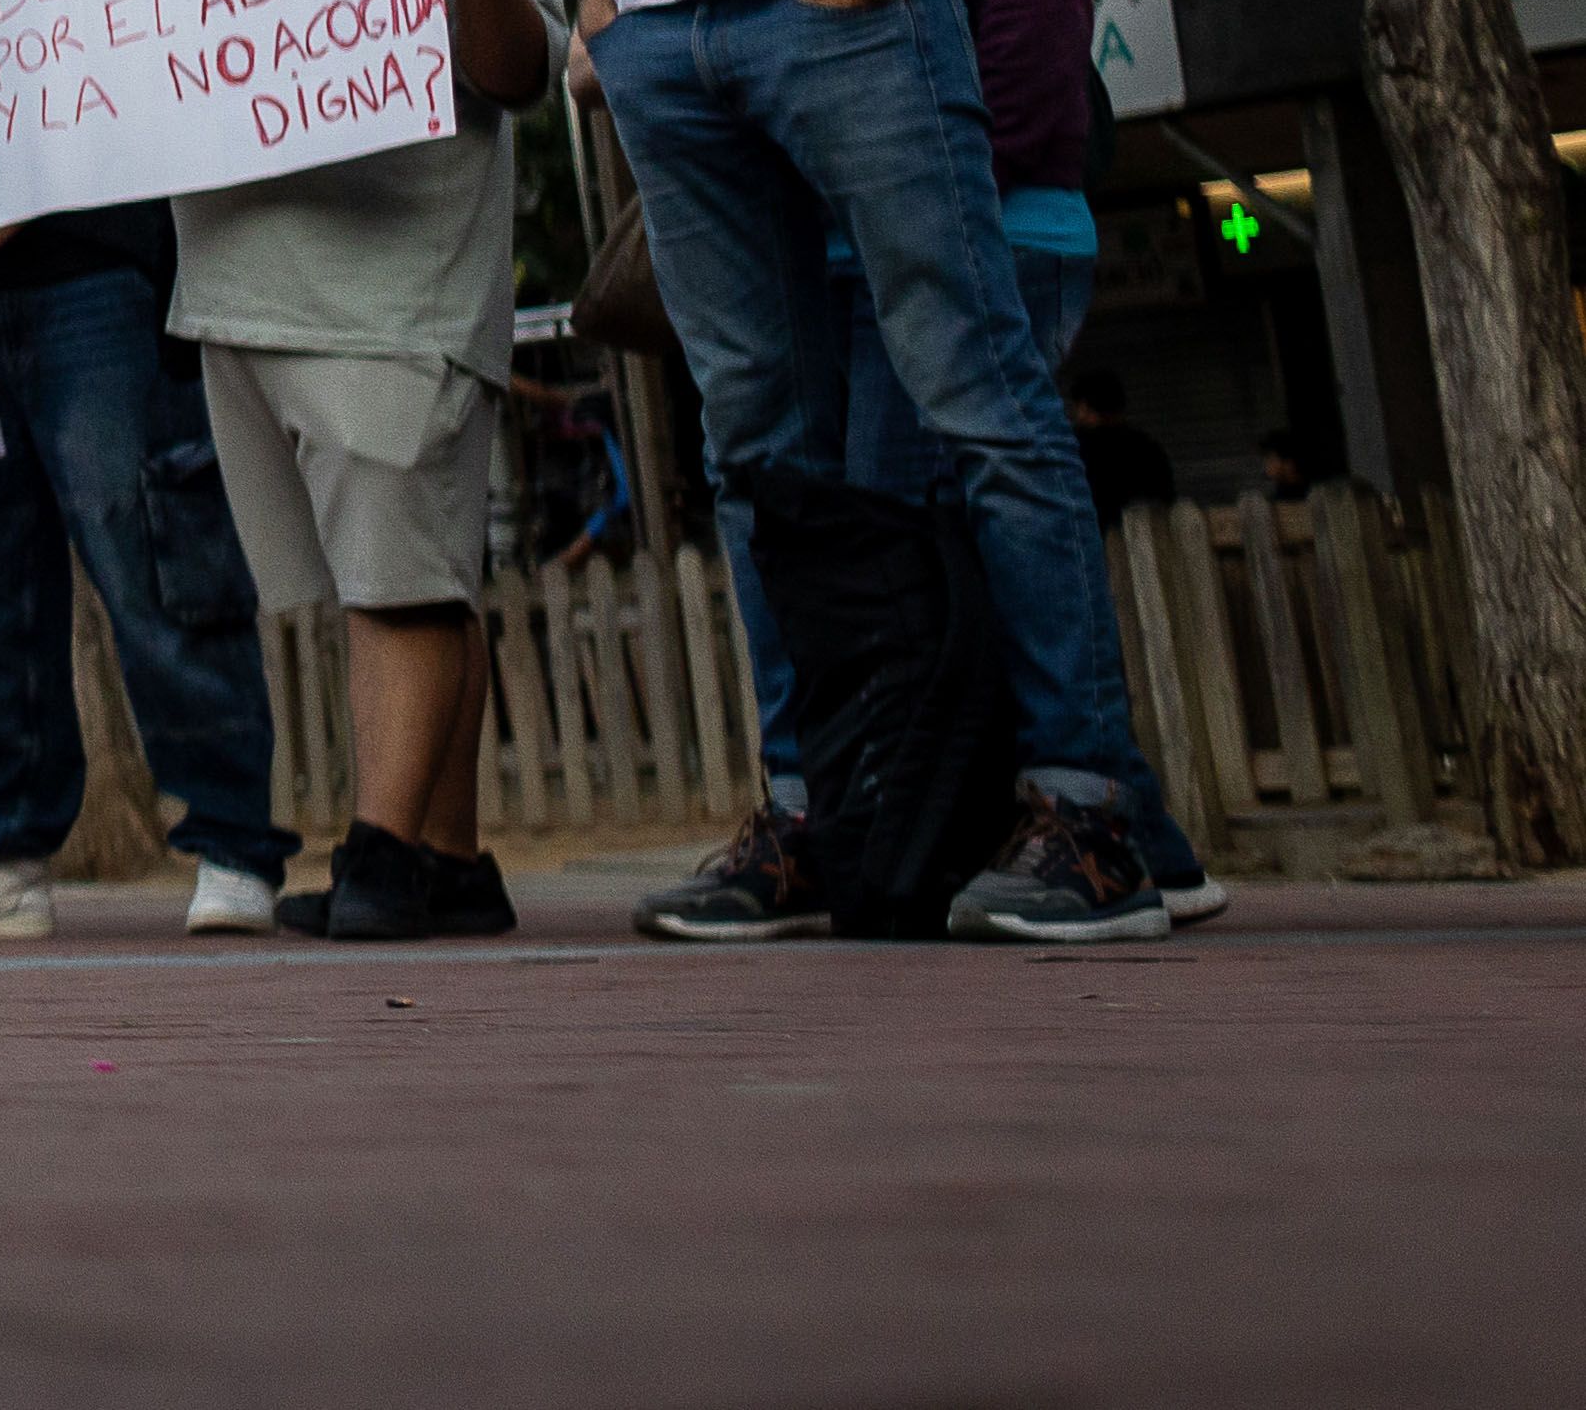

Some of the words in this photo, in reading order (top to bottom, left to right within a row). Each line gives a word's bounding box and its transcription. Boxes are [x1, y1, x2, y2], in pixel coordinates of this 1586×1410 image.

[41, 75, 118, 131] LA
[167, 34, 256, 103] NO
[251, 43, 445, 147] DIGNA?
